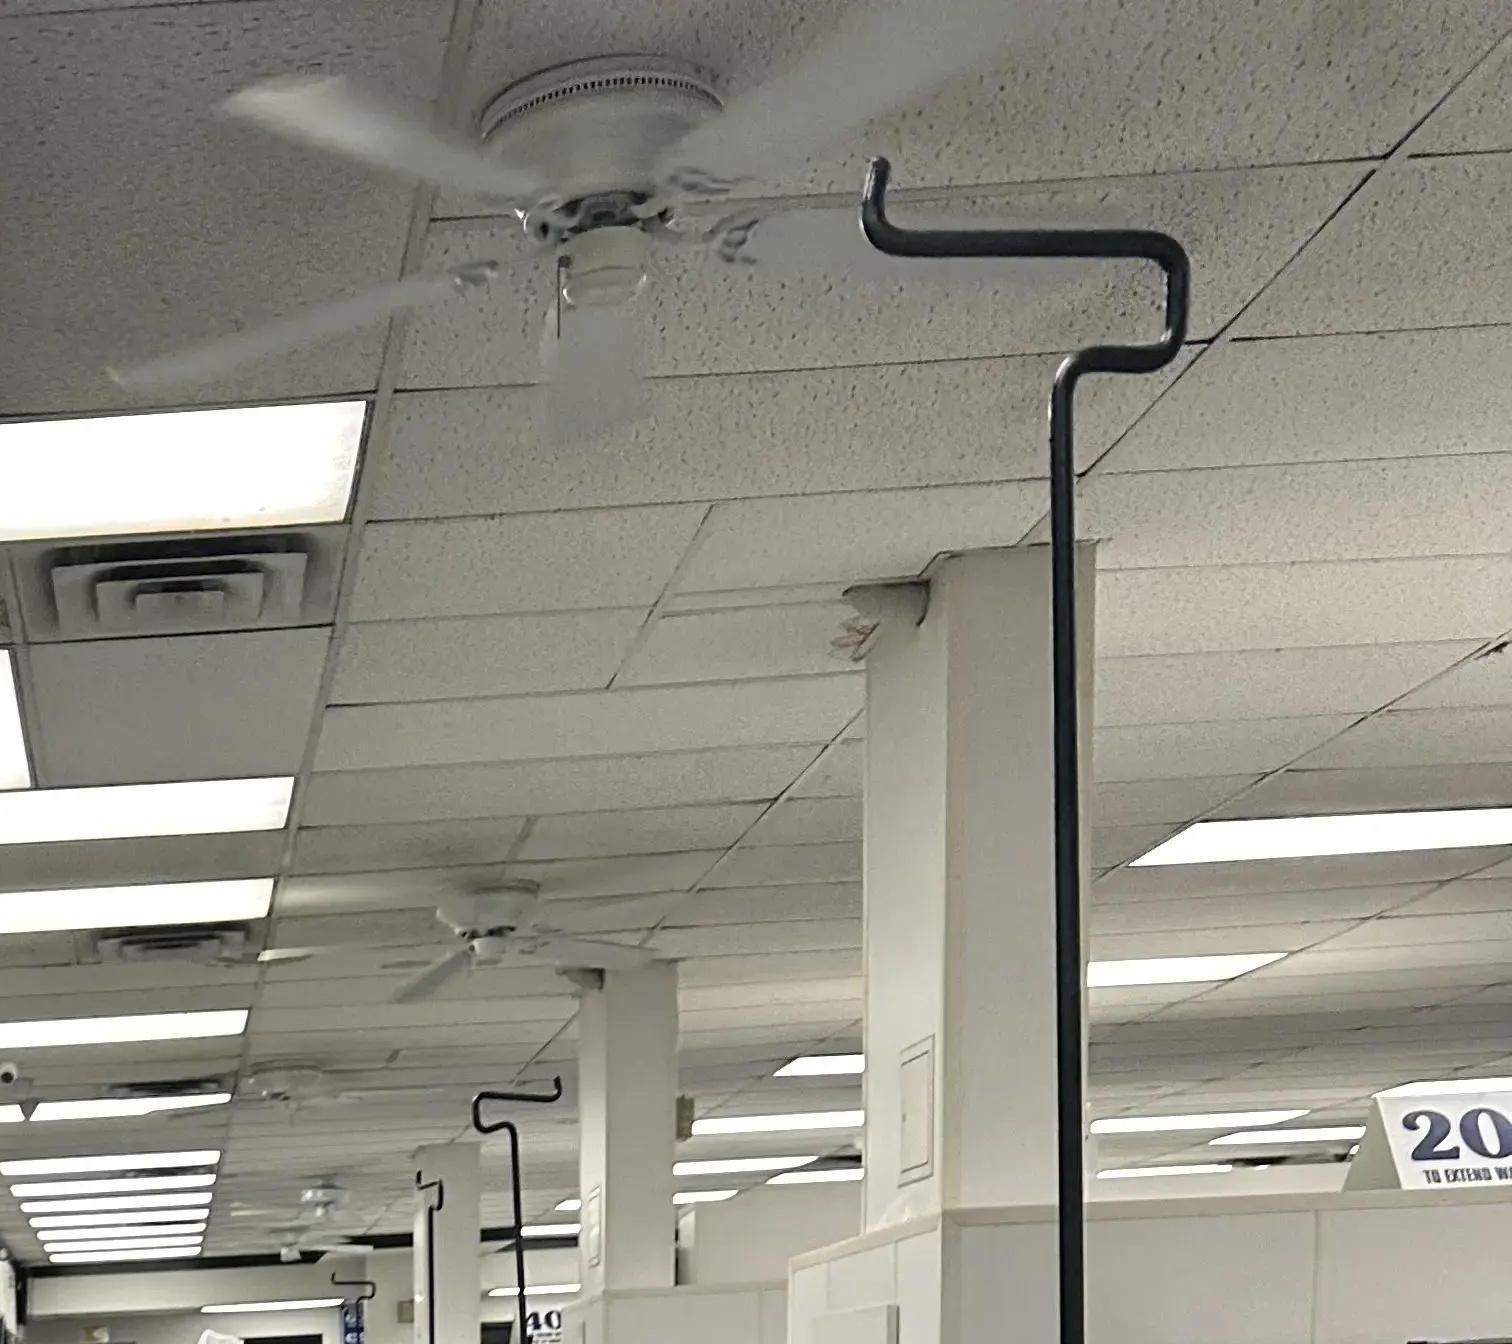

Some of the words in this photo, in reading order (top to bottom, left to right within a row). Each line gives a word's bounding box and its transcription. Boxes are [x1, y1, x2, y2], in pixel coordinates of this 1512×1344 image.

[1402, 1108, 1512, 1161] 20
[1422, 1169, 1442, 1184] TO
[1444, 1168, 1492, 1183] EXTEND
